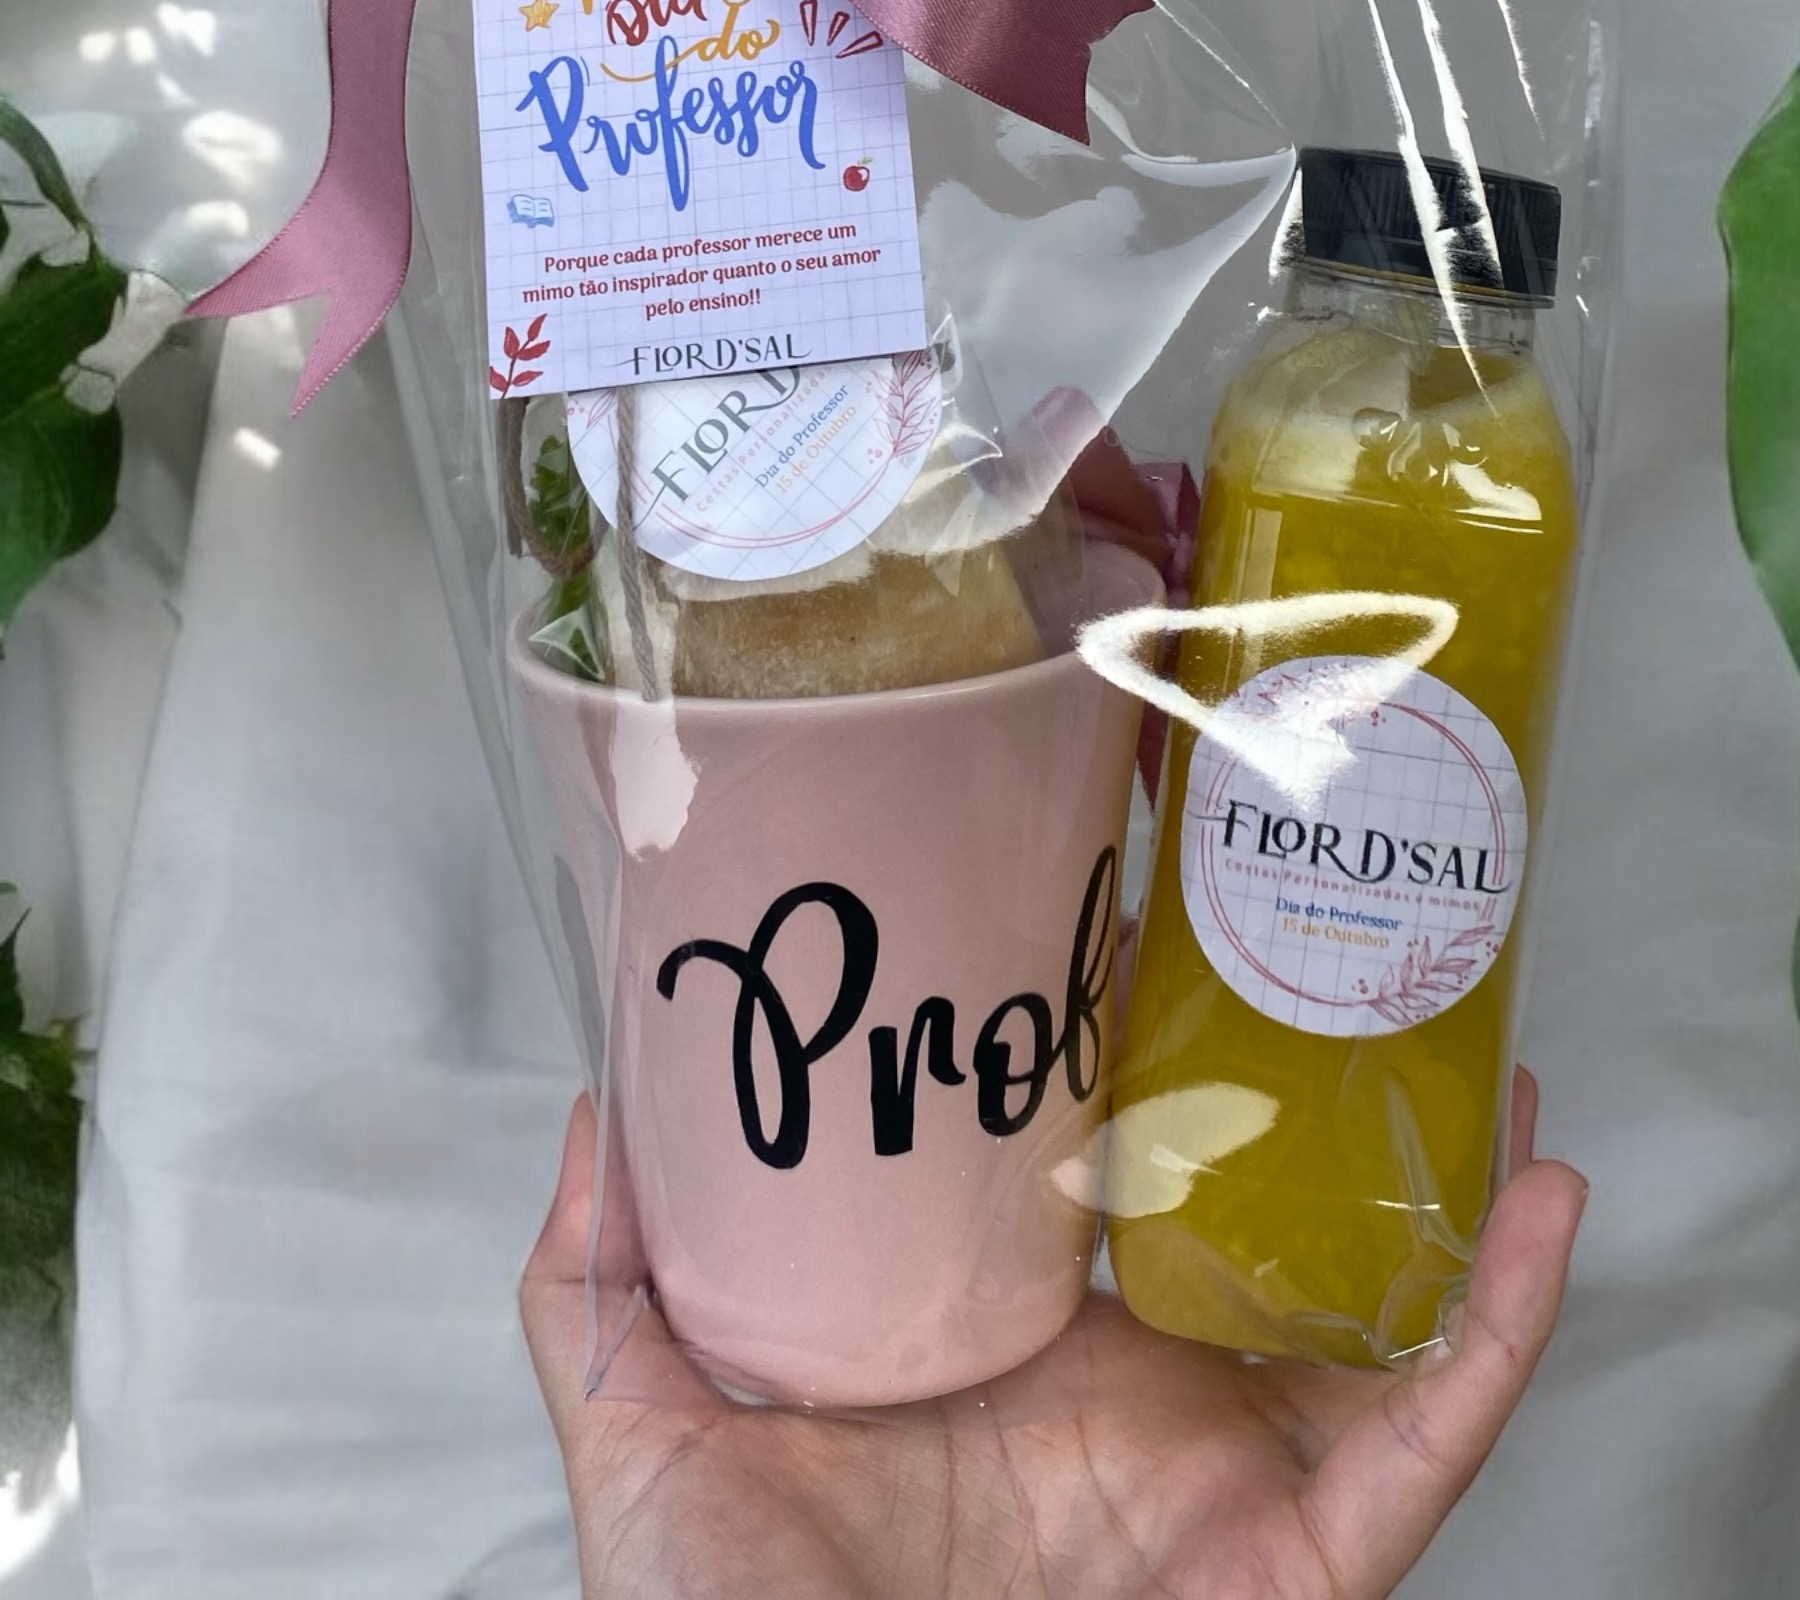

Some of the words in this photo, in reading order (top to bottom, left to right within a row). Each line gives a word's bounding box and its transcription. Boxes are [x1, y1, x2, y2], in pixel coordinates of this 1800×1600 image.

[515, 34, 826, 212] Professor
[522, 284, 575, 304] mimo
[579, 278, 609, 297] tão
[612, 268, 709, 293] inspirador
[713, 260, 777, 283] quanto
[780, 259, 793, 273] o
[795, 254, 828, 271] seu
[831, 247, 882, 267] amor
[544, 252, 609, 273] Porque
[613, 246, 657, 265] cada
[662, 237, 751, 263] professor
[755, 230, 823, 248] merece
[827, 224, 857, 240] um
[645, 295, 685, 321] pelo
[688, 288, 761, 313] ensino!!
[613, 343, 712, 375] FLOR
[714, 332, 814, 371] D'SAL
[632, 390, 765, 532] FLOR
[755, 462, 780, 489] Dia
[778, 444, 796, 465] do
[792, 384, 850, 447] Professor
[775, 474, 794, 494] 15
[791, 458, 809, 478] de
[806, 404, 857, 460] Outubro
[696, 465, 740, 513] Cestas
[1190, 799, 1352, 879] FLOR
[1358, 828, 1513, 894] D'SAL
[1224, 857, 1279, 880] Cestas
[1283, 870, 1410, 902] Personalizadas
[1428, 894, 1482, 913] mimos
[1275, 896, 1301, 915] Dia
[1304, 902, 1326, 920] do
[1329, 907, 1402, 932] Professor
[1281, 917, 1298, 933] 15
[1301, 921, 1320, 937] de
[1324, 925, 1390, 949] Outubro
[657, 844, 1117, 1170] Prof
